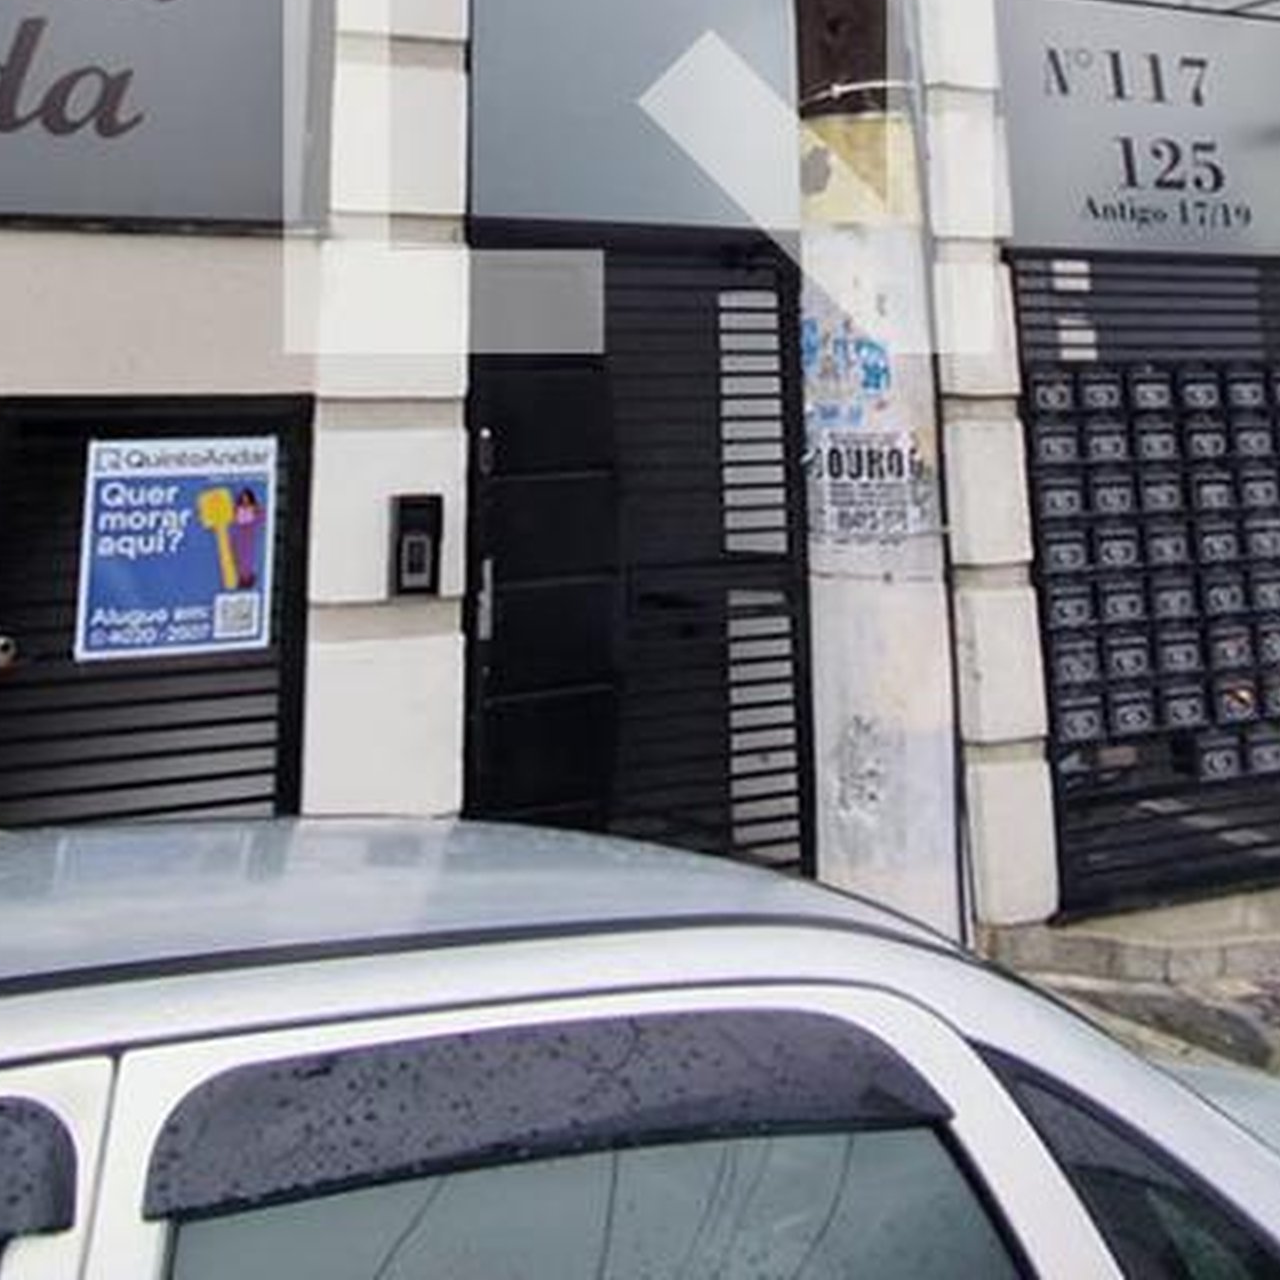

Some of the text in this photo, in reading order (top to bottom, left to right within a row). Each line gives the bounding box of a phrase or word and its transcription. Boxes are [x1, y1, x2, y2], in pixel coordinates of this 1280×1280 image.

[1106, 50, 1208, 107] 117
[1117, 136, 1225, 194] 125
[1083, 196, 1253, 230] Antigo 17/19
[124, 447, 270, 471] QuintoAndar
[101, 482, 179, 507] Quer
[97, 508, 192, 532] morar
[96, 530, 185, 560] aqui?
